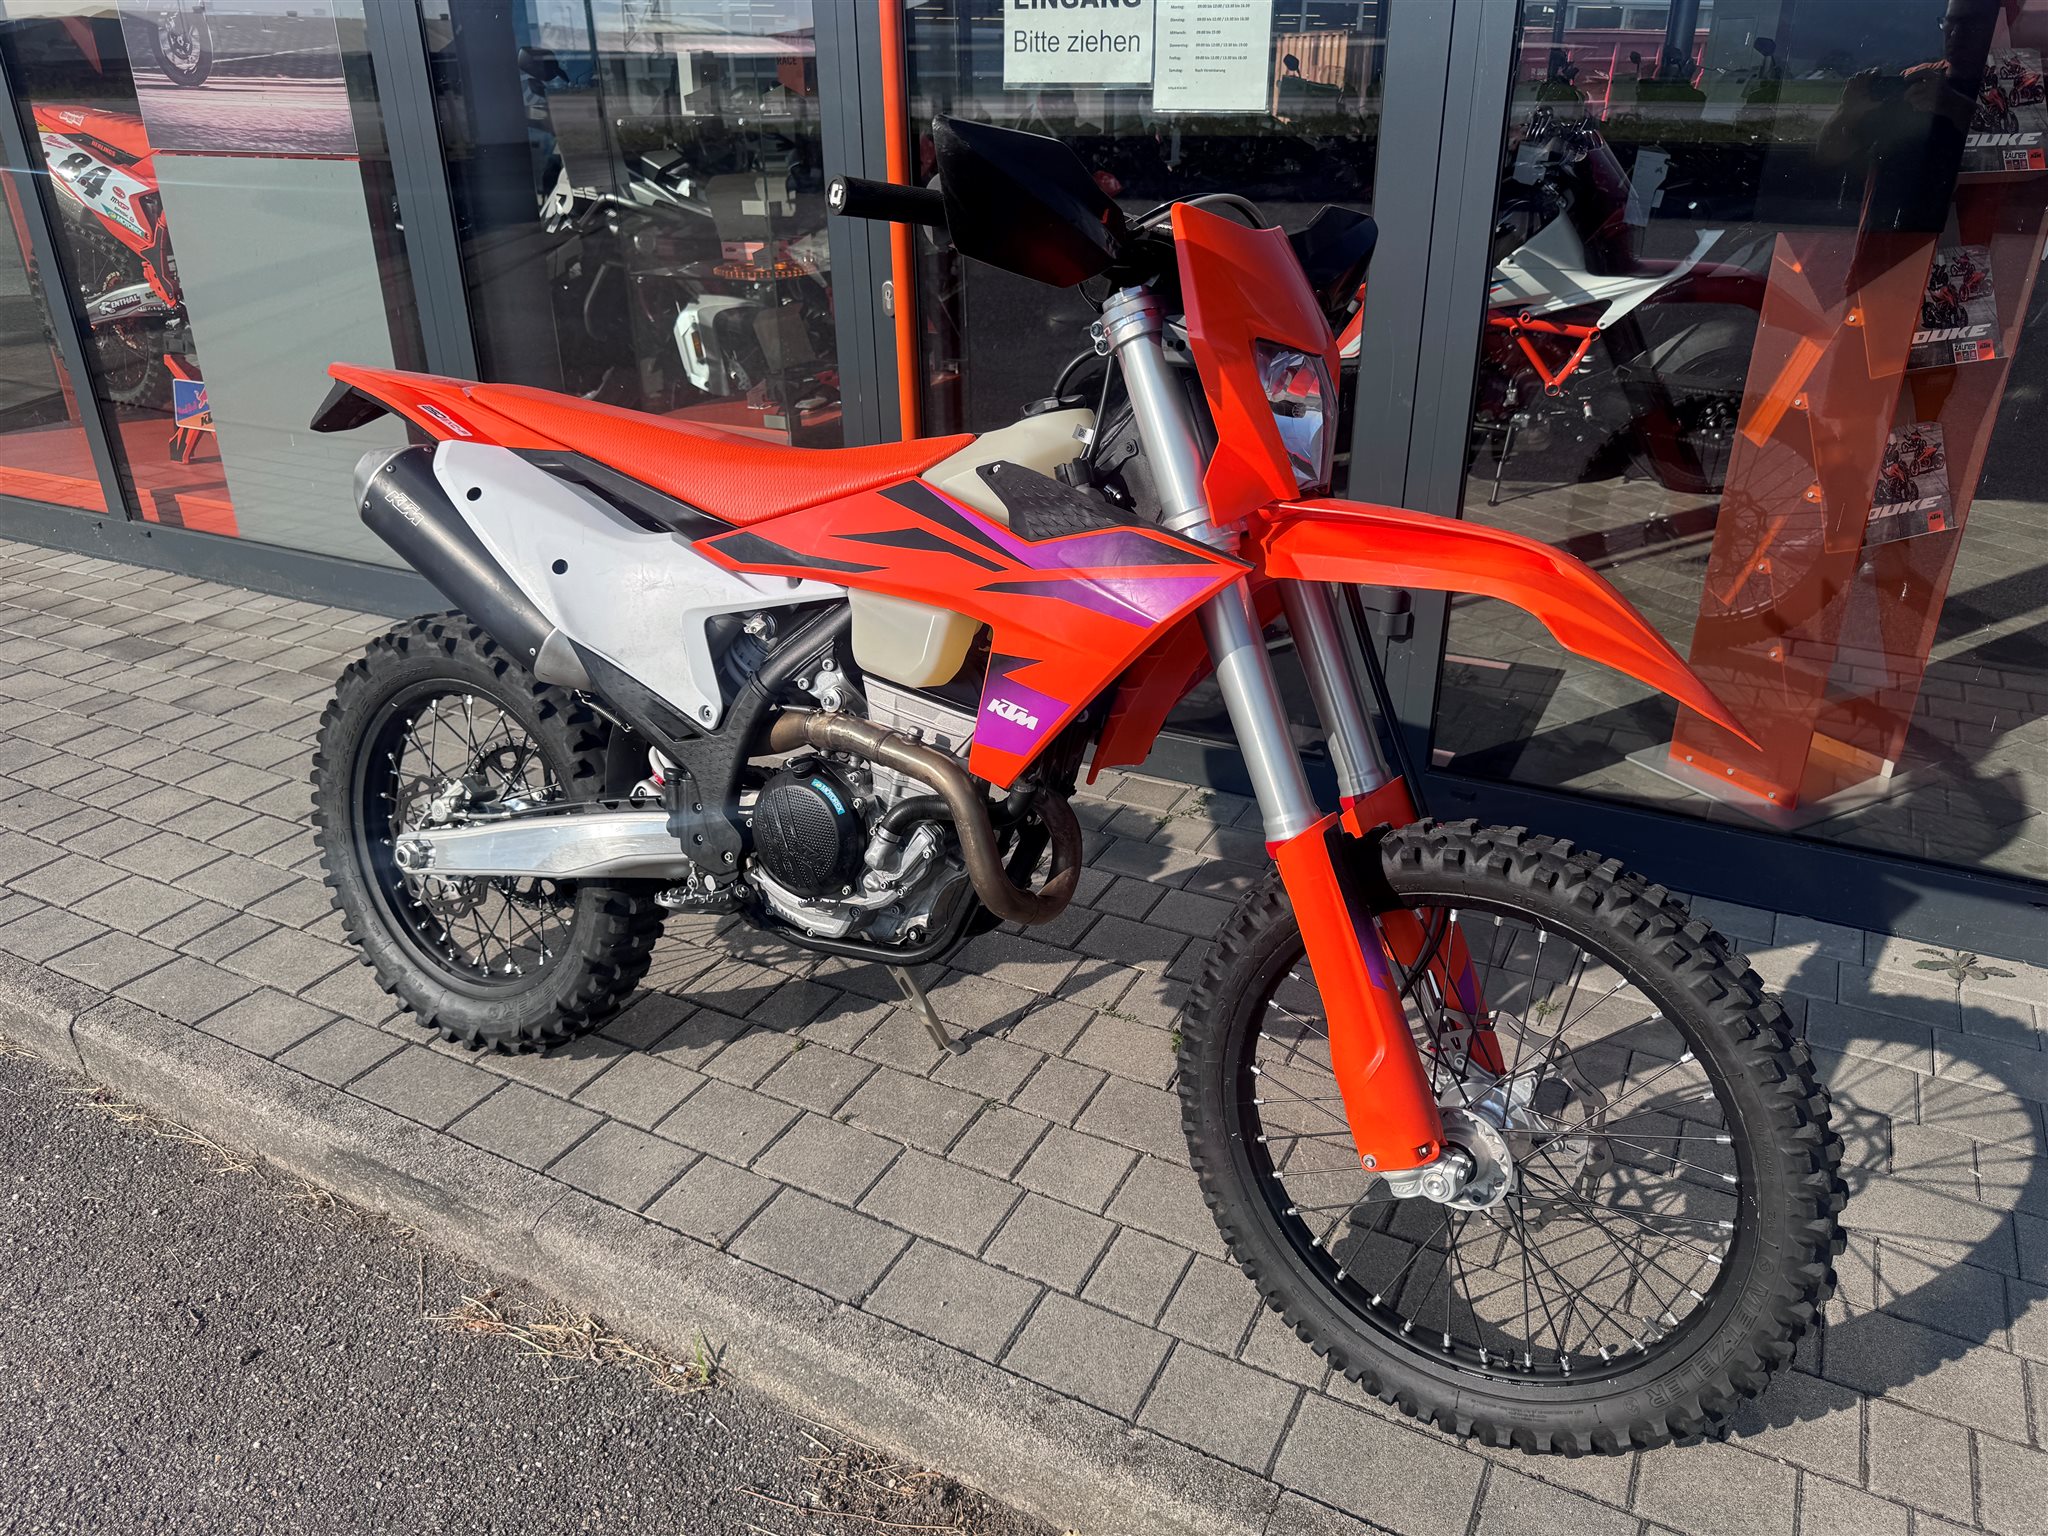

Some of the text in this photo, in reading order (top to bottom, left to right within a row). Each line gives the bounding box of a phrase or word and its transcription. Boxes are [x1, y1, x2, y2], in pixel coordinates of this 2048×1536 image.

[1014, 29, 1140, 53] Bitte ziehen
[1966, 132, 2043, 147] DUKE
[57, 152, 113, 200] 84
[1911, 323, 1992, 345] DUKE
[385, 490, 424, 526] KTM
[1867, 495, 1943, 521] DUKE
[986, 698, 1039, 731] KTM
[819, 783, 845, 814] MOTOREX
[1648, 1282, 1770, 1409] METZELER
